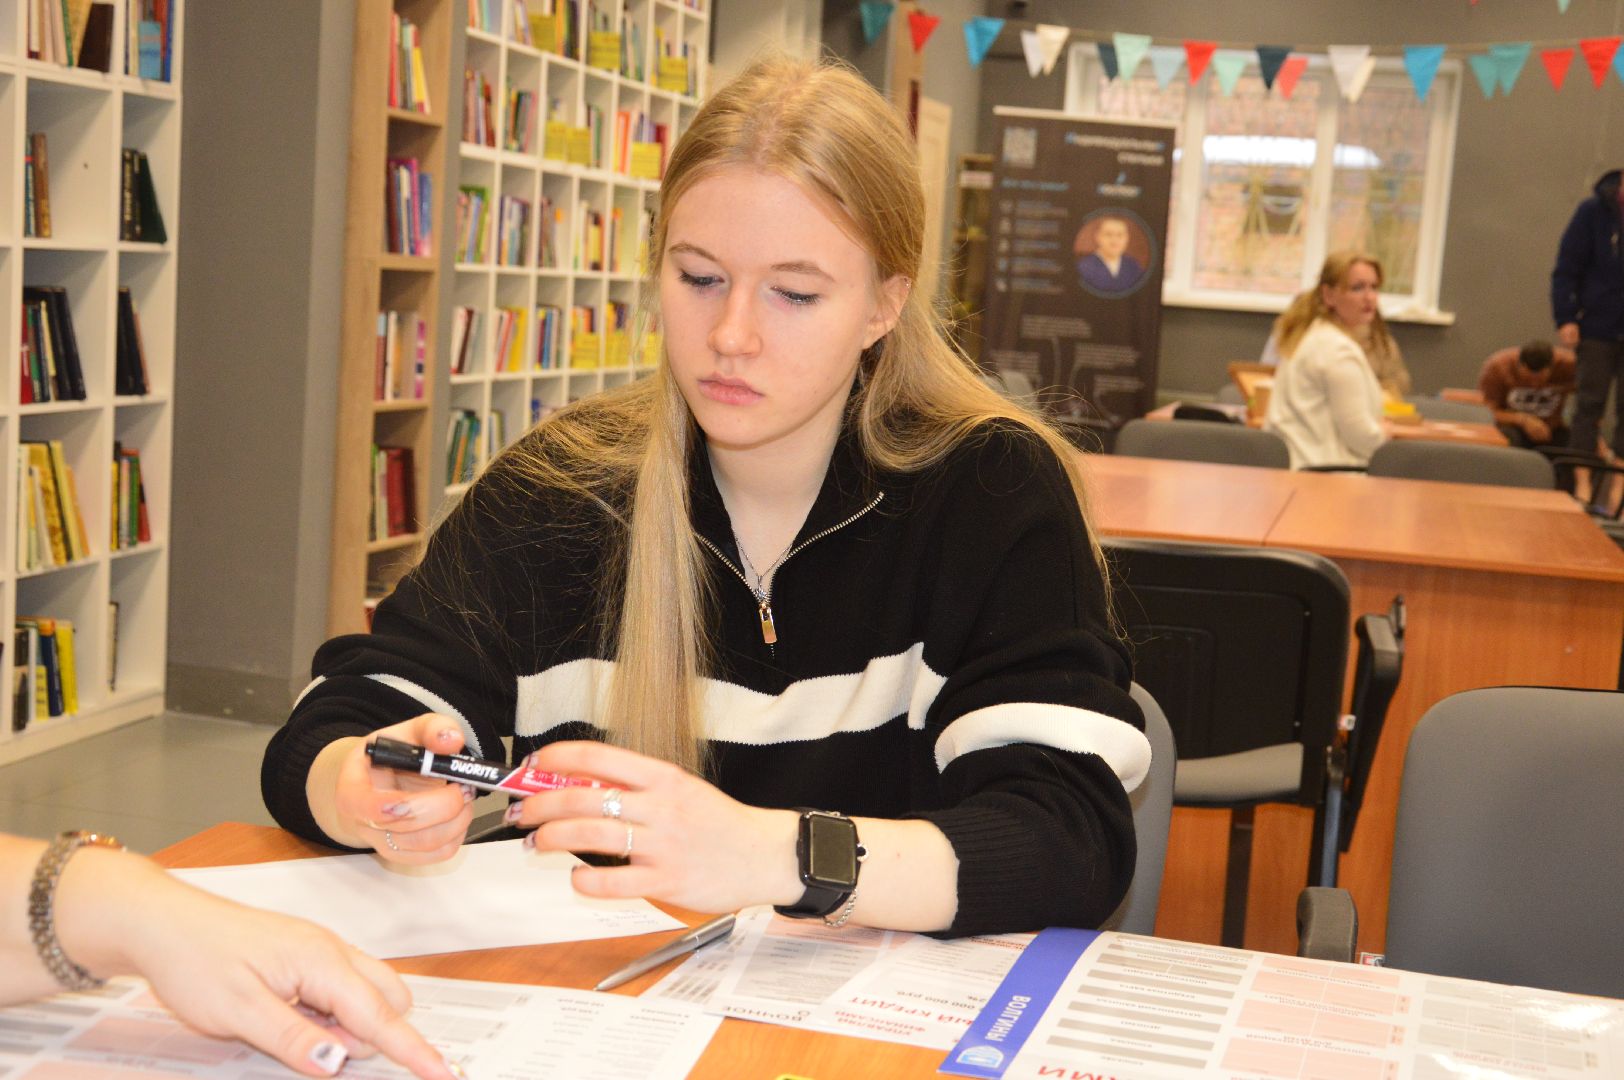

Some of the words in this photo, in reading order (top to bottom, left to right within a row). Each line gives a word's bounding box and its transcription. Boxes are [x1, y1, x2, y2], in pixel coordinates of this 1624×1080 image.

[450, 759, 499, 779] DUORITE
[847, 996, 932, 1019] КРЕДИТ
[985, 995, 1031, 1041] ВОЛГИНЫ
